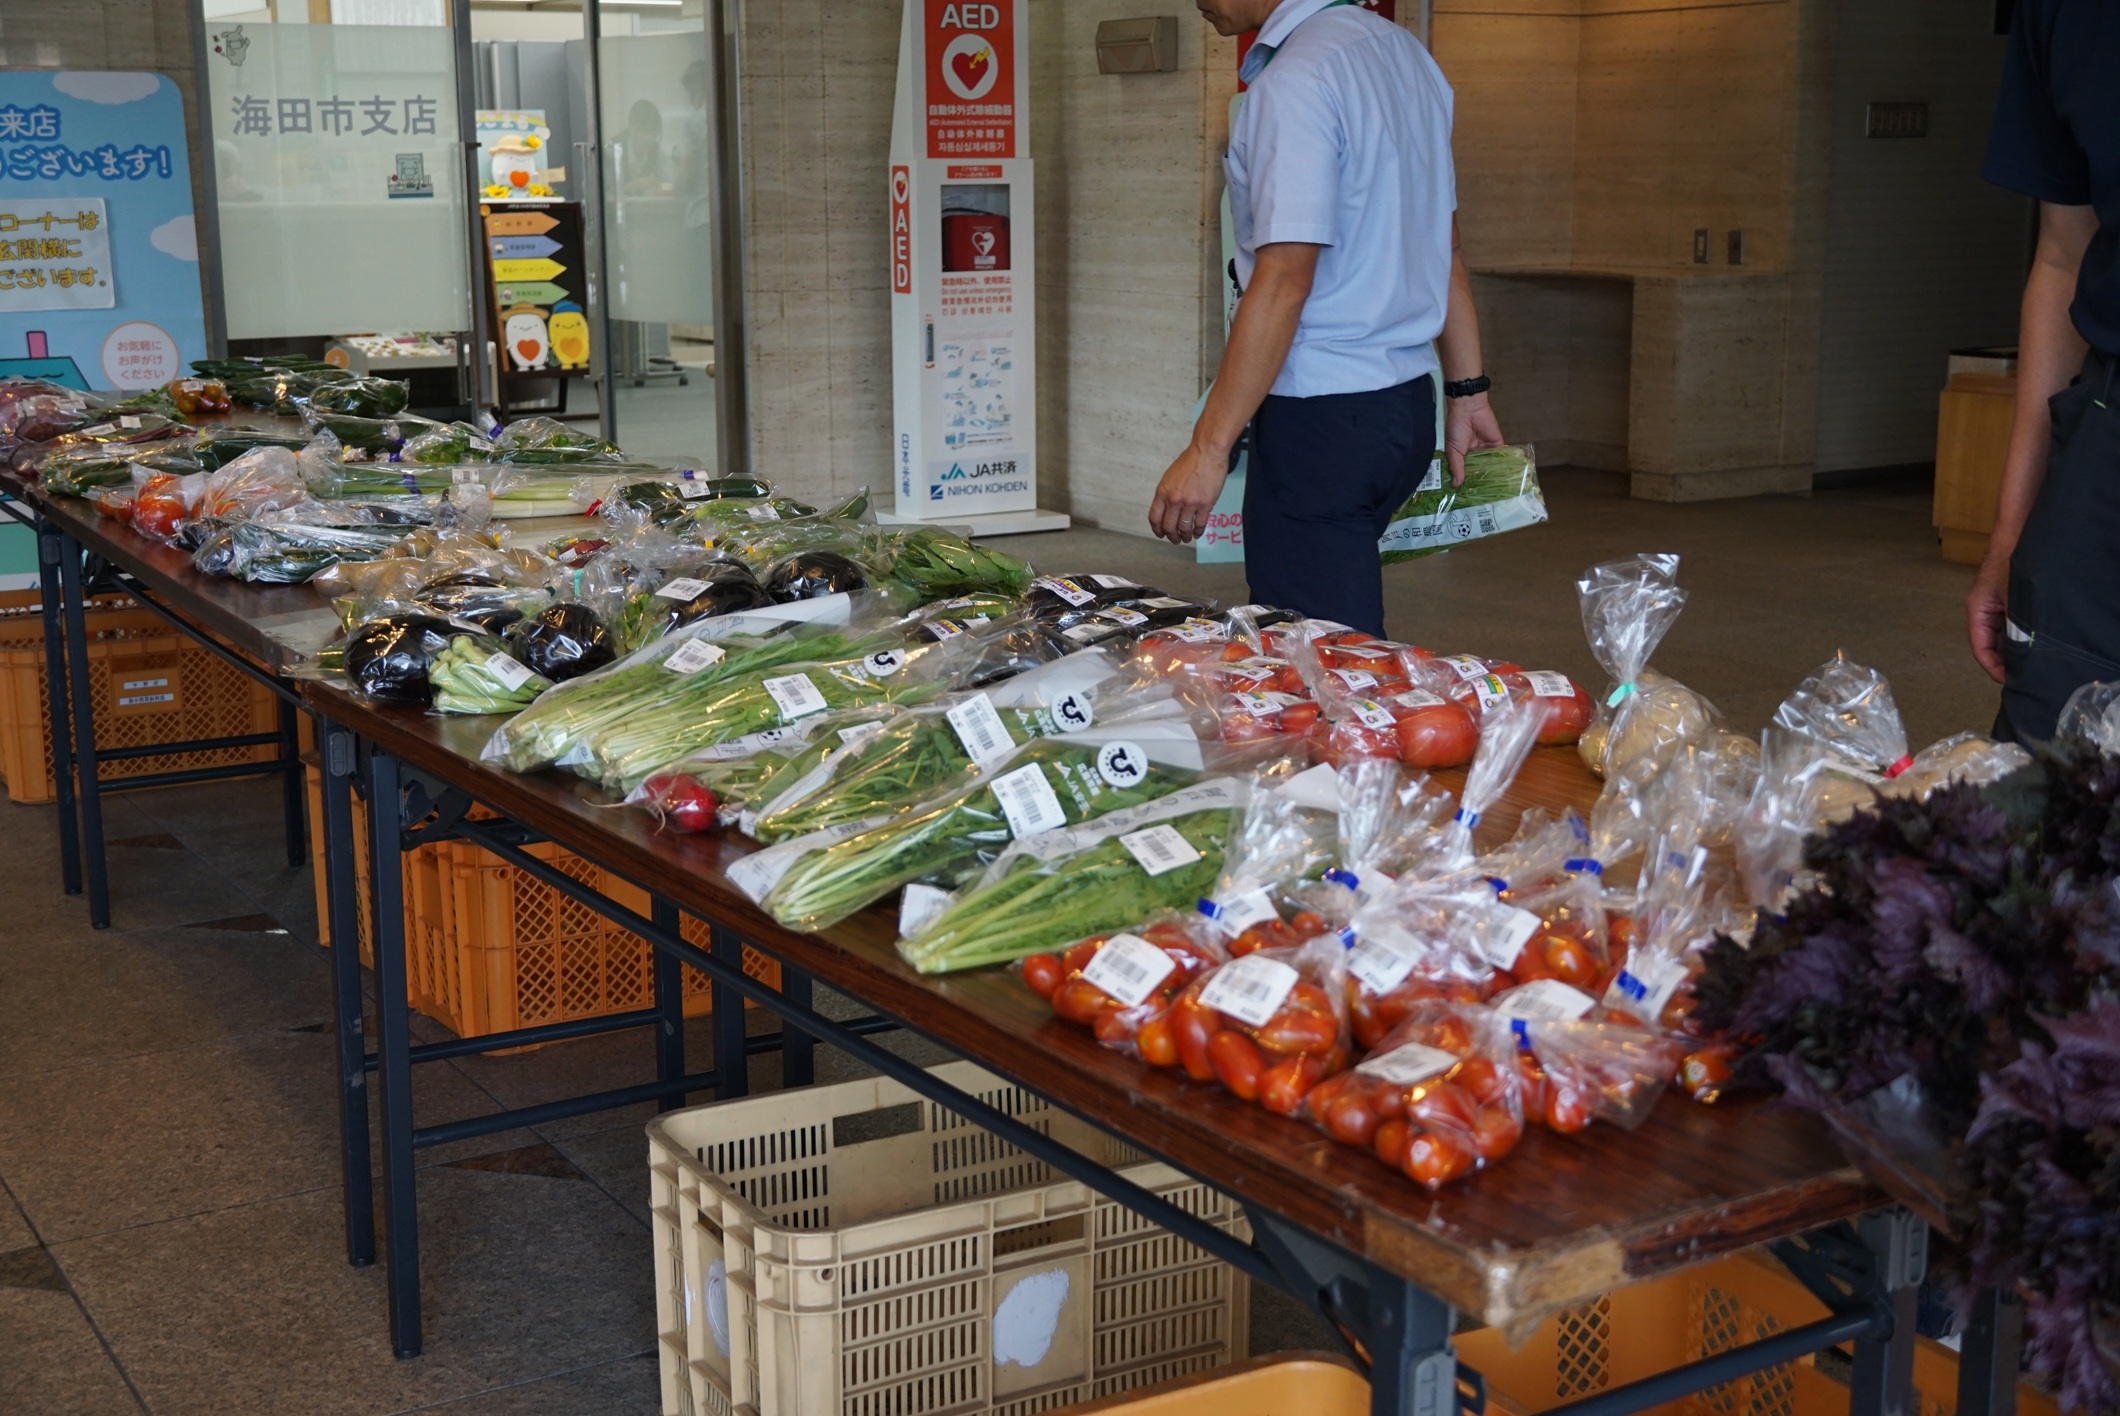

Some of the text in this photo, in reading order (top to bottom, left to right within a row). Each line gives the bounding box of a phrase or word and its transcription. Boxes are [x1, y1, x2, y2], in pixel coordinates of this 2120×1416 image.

[939, 3, 1000, 29] AED
[0, 108, 57, 139] 来店
[231, 94, 438, 137] 海田市支店
[0, 148, 170, 177] ございます!
[0, 210, 100, 232] コーナーは
[0, 238, 83, 260] 玄関横に
[895, 208, 909, 288] AED
[117, 340, 162, 352] お気軽に
[118, 355, 162, 366] お声がけ
[120, 369, 165, 380] ください
[970, 460, 1017, 478] JA共済
[947, 480, 1028, 497] NIHON KOHDEN
[968, 744, 980, 760] ¥150
[1012, 816, 1022, 834] ¥150
